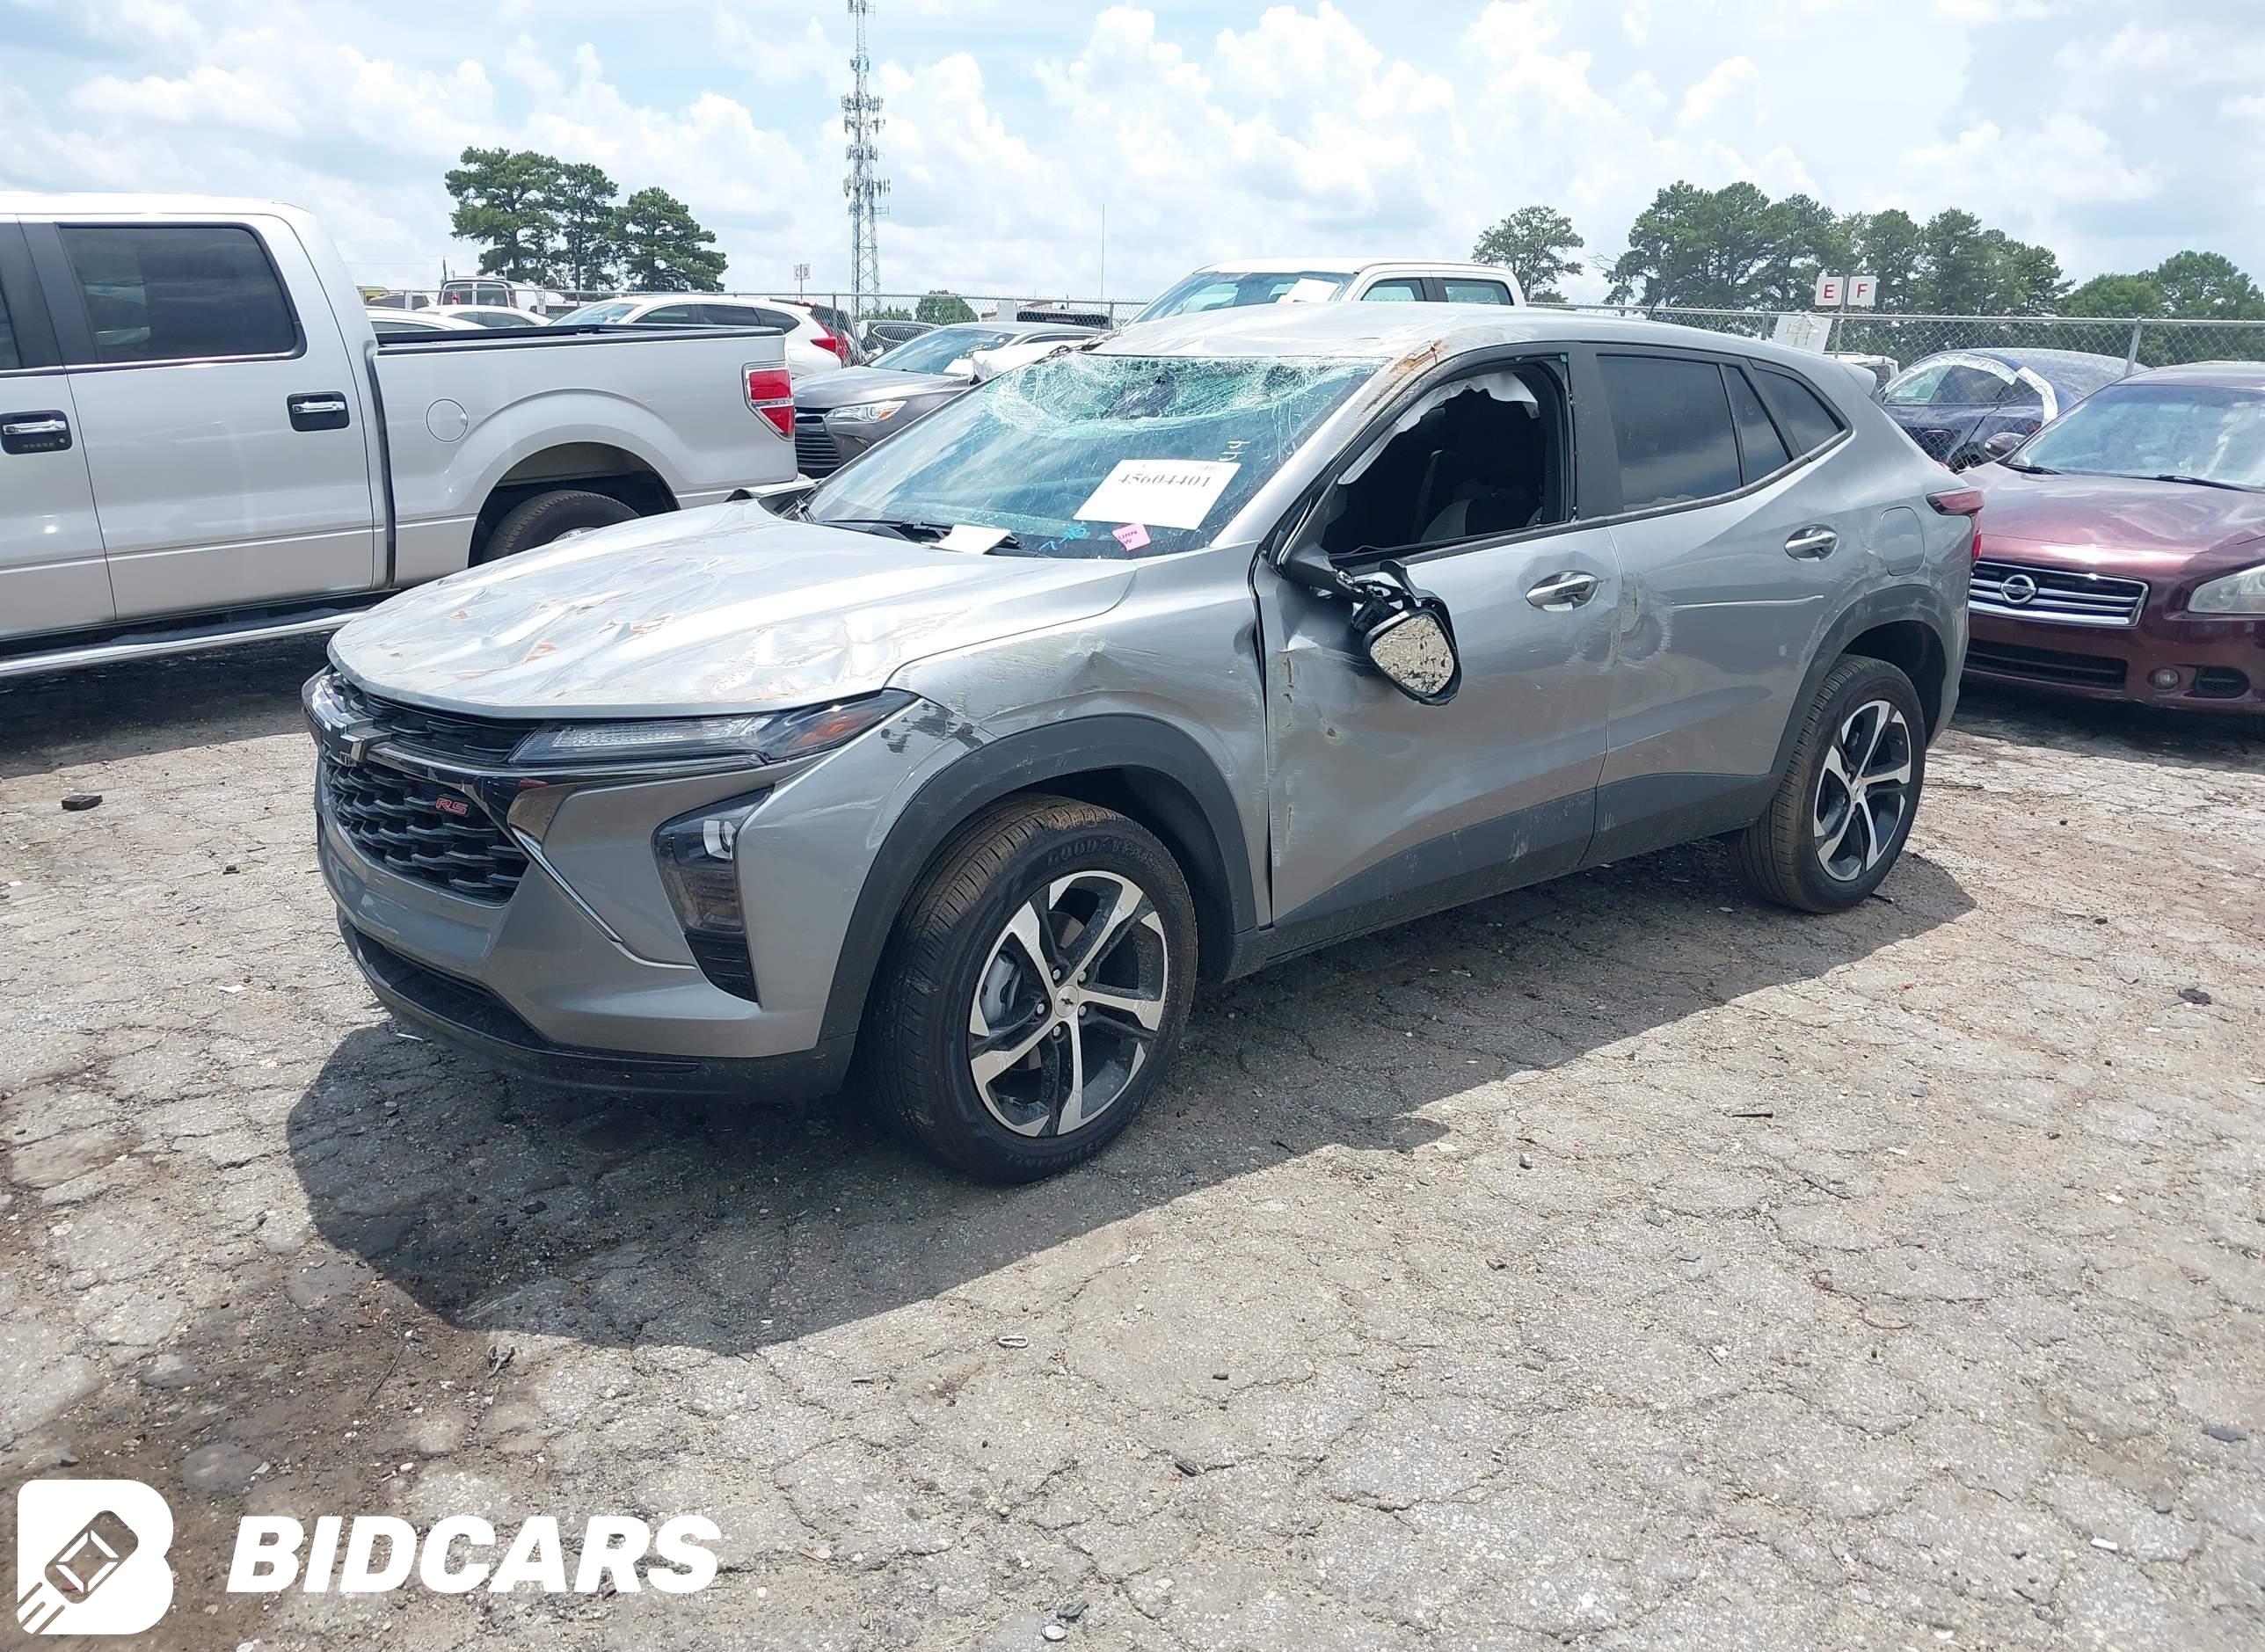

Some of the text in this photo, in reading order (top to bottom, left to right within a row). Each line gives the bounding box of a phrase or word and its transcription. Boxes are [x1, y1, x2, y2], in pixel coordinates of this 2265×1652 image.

[1823, 283, 1836, 299] E
[1856, 283, 1868, 299] F
[436, 797, 469, 814] RS
